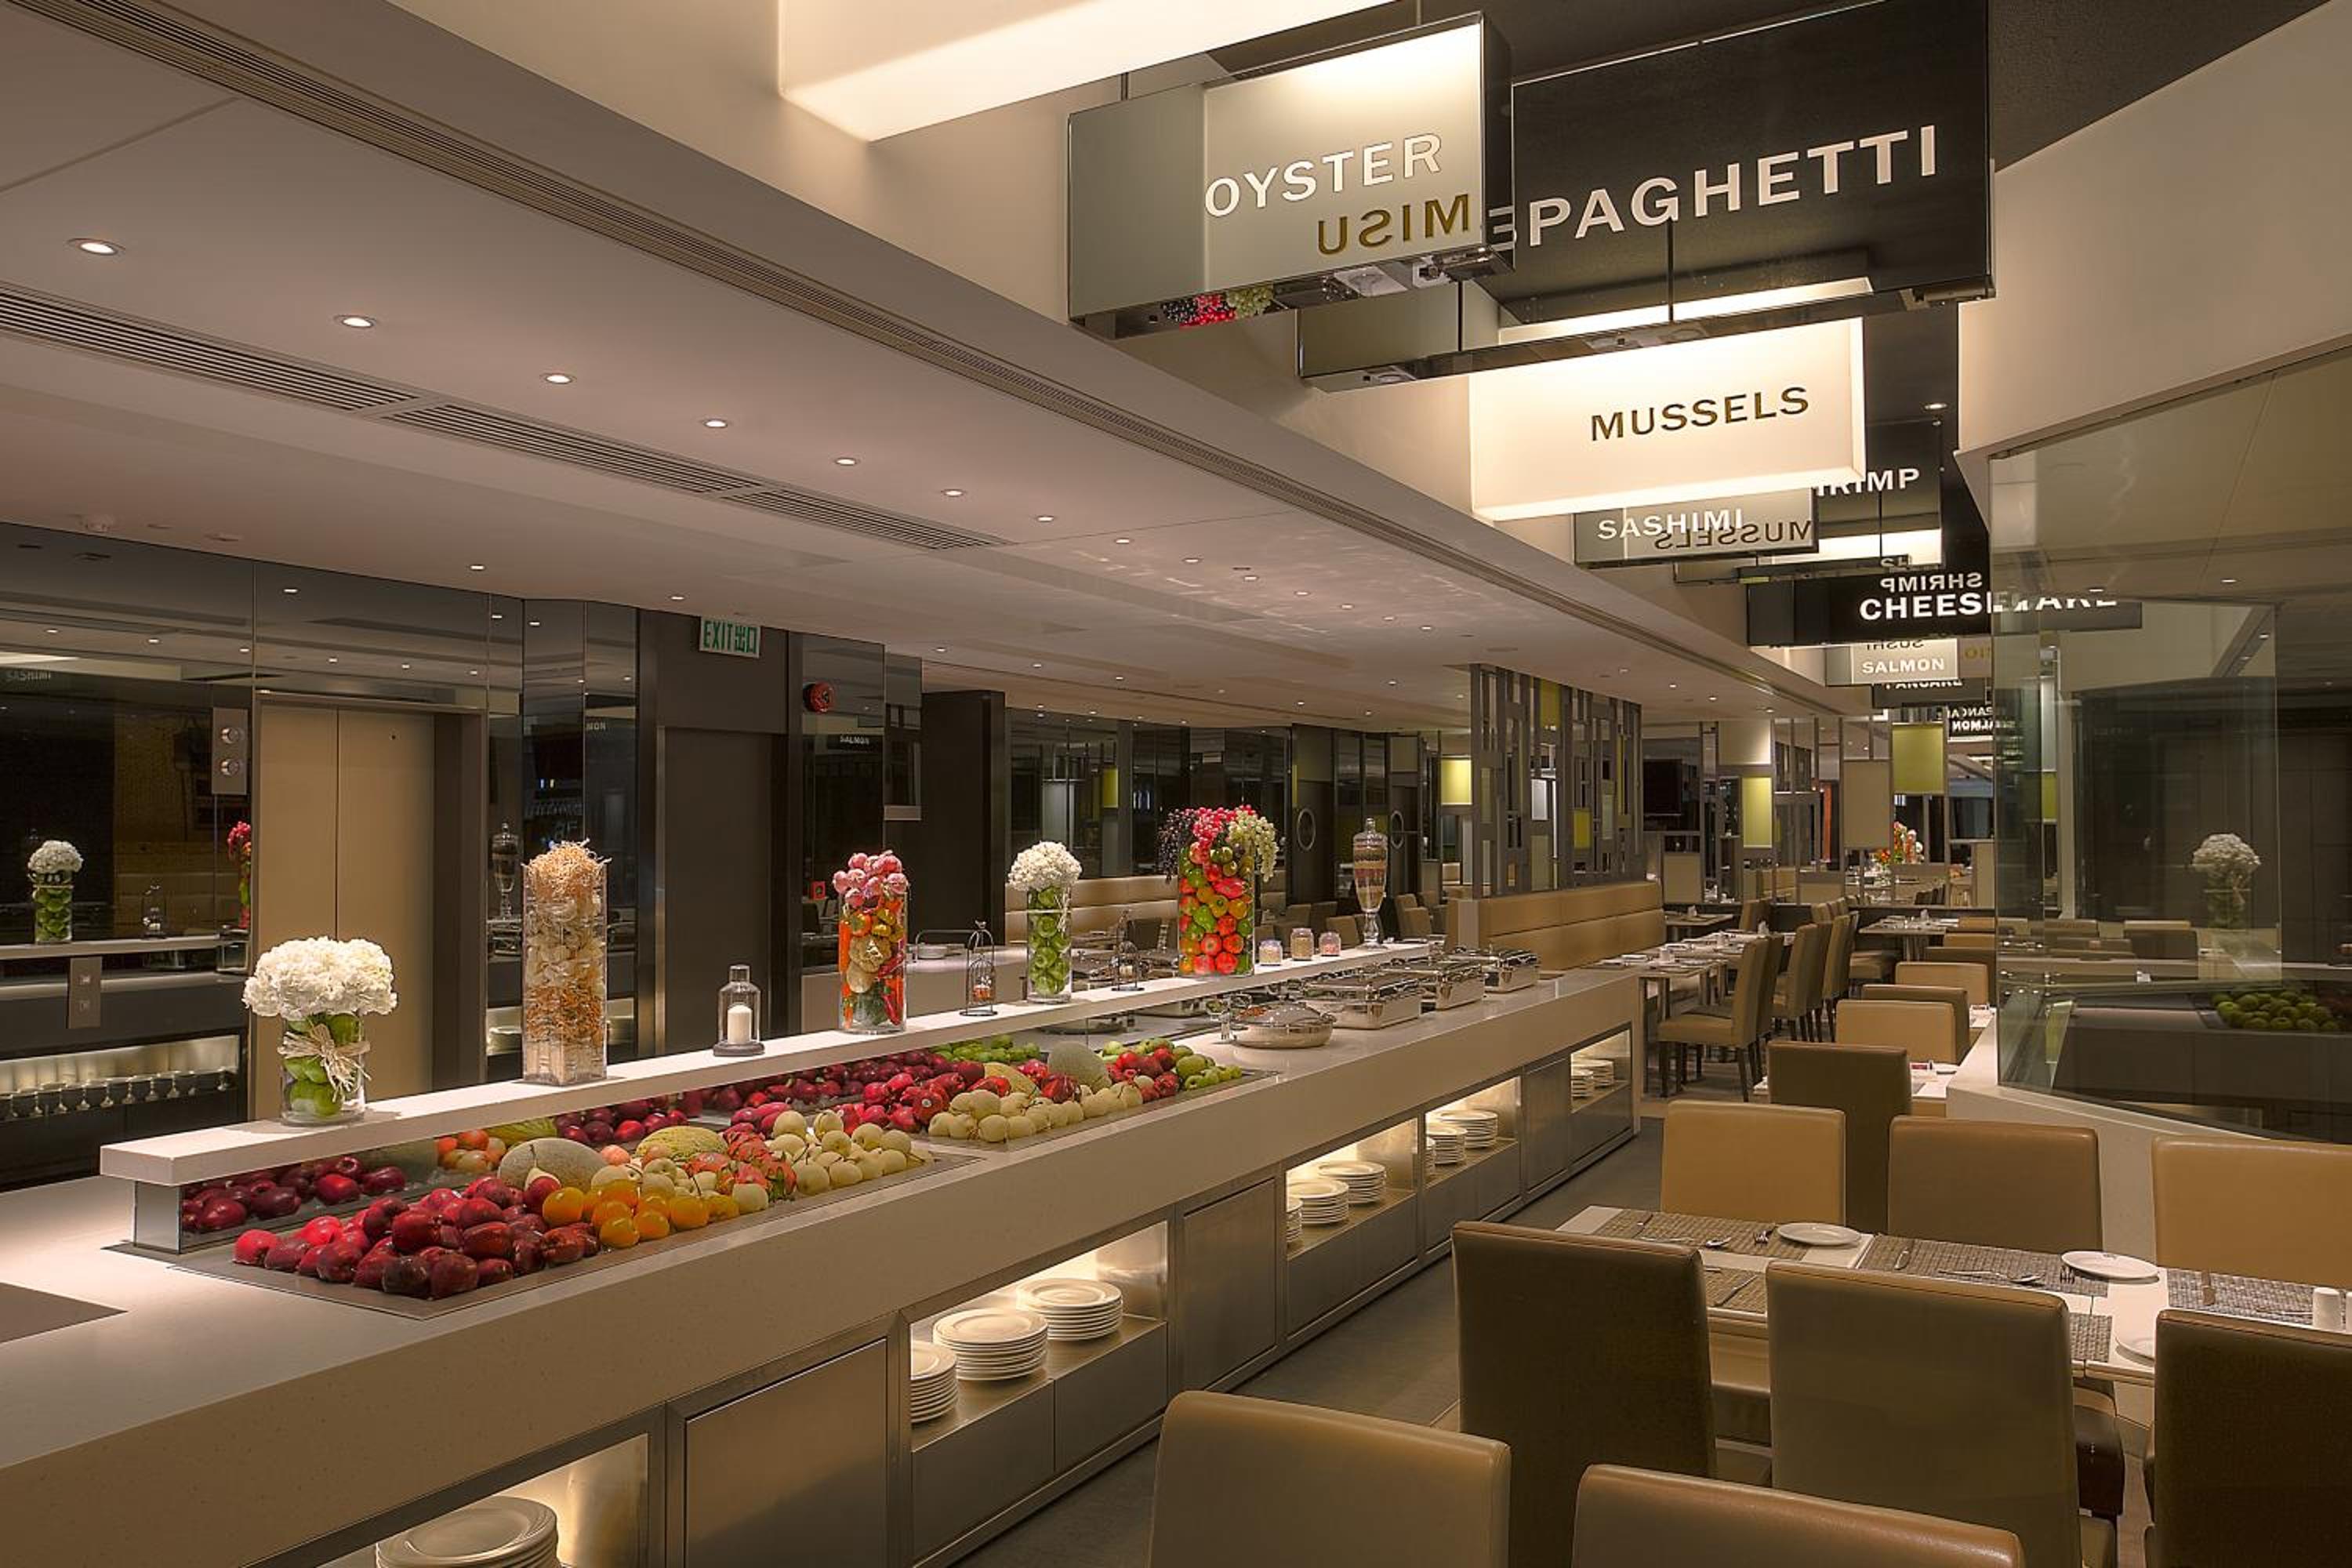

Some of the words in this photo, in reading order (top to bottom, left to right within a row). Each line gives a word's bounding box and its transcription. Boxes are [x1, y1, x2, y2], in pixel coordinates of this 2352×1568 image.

[1205, 132, 1443, 218] OYSTER
[1513, 125, 1936, 247] PAGHETTI
[1592, 387, 1809, 441] MUSSELS
[1817, 468, 1920, 496] RIMP
[1598, 508, 1744, 540] SASHIMI
[703, 620, 733, 652] EXIT
[1862, 658, 1945, 674] SALMON
